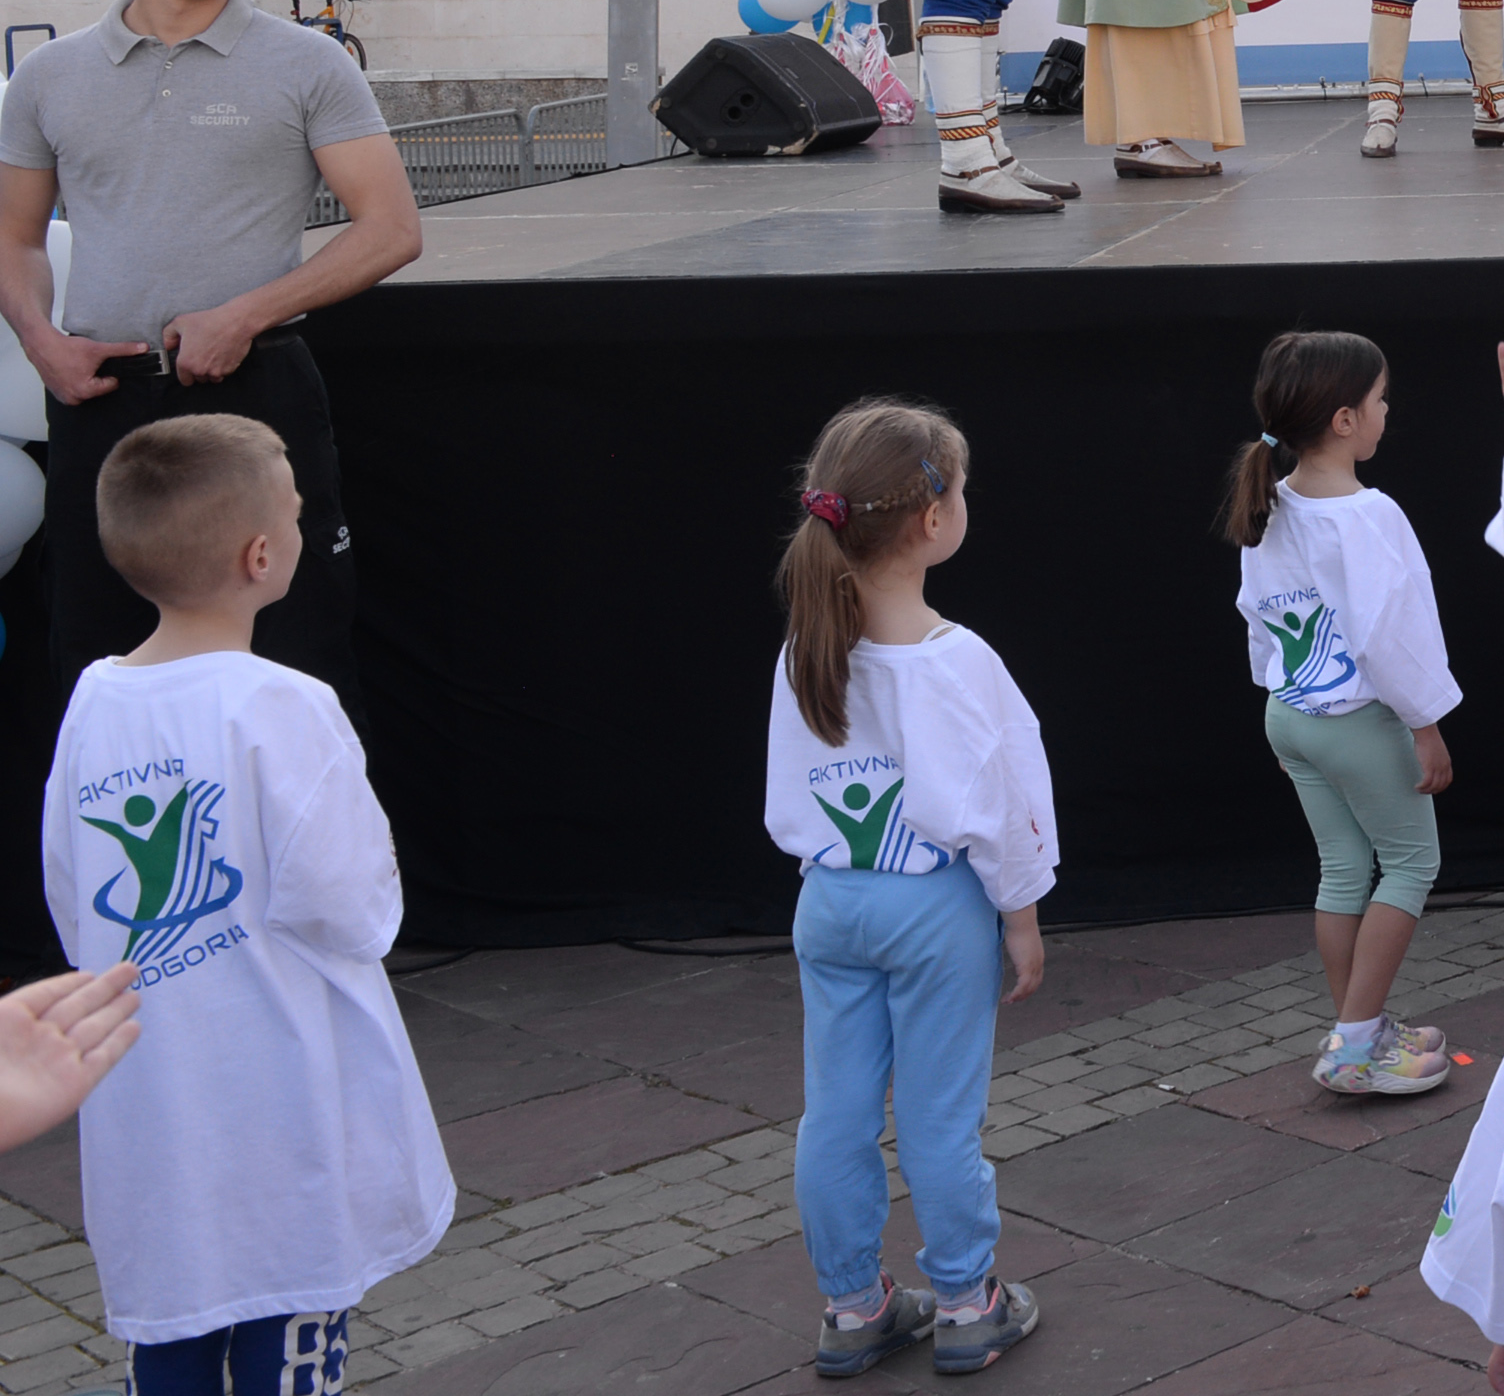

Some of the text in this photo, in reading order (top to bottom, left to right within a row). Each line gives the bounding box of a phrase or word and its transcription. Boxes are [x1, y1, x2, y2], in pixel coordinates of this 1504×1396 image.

[190, 115, 251, 125] SECURITY
[205, 104, 237, 115] SCA
[79, 758, 185, 808] AKTIVNA
[808, 754, 903, 786] AKTIVNA
[130, 924, 250, 991] ODGORIA
